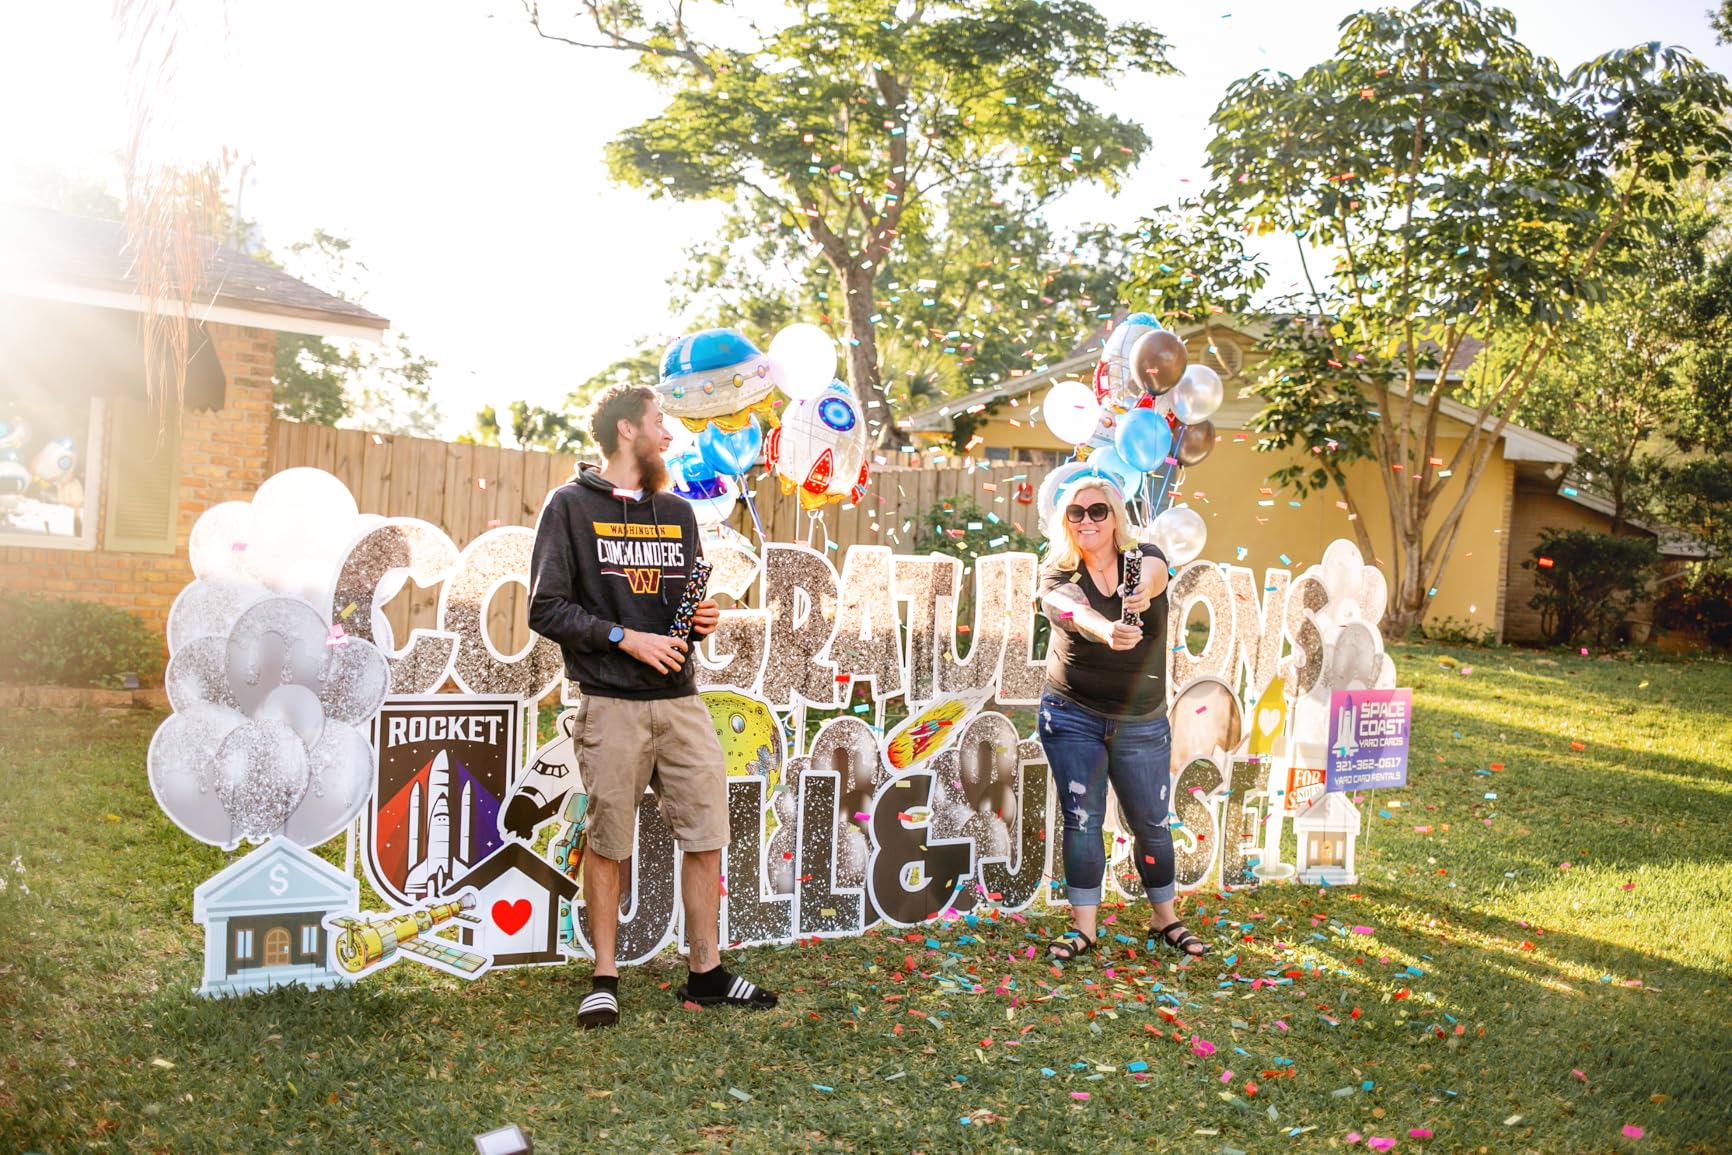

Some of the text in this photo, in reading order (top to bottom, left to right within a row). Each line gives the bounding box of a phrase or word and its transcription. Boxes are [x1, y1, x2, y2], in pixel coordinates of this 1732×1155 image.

[609, 525, 666, 535] WAHINGTN
[597, 538, 685, 567] COMMANDERS
[1360, 701, 1406, 718] SPACE
[388, 714, 502, 748] ROCKET
[1360, 719, 1405, 736] COAST
[1359, 737, 1404, 748] YARD CARDS
[1335, 757, 1402, 772] 321-362-0617
[1293, 769, 1321, 787] FOR
[1334, 771, 1401, 785] YARD CARD RENTALS
